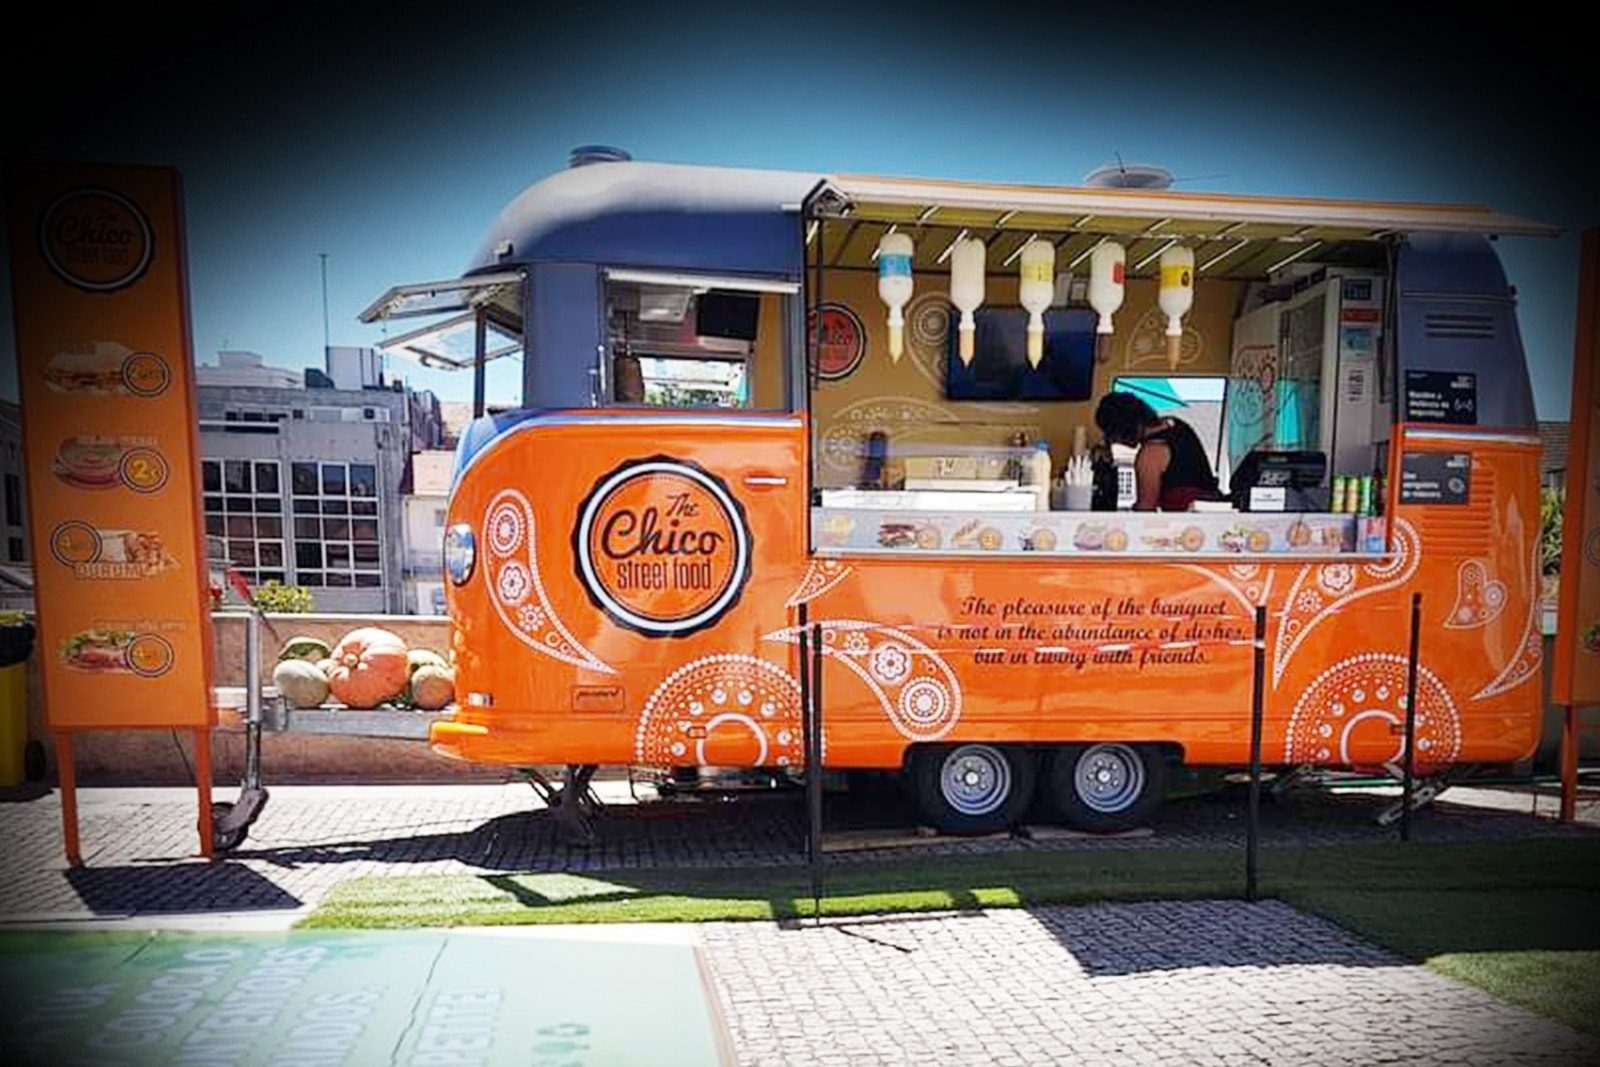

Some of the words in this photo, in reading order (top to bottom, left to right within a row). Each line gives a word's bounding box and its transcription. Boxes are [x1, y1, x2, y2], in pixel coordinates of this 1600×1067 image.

[55, 214, 136, 246] Chico
[666, 493, 699, 517] The
[601, 507, 724, 560] Chico
[617, 560, 667, 590] street
[673, 558, 711, 590] food
[961, 596, 997, 616] The
[1002, 598, 1085, 621] pleasure
[1091, 598, 1111, 621] of
[1117, 598, 1145, 616] the
[1151, 598, 1227, 621] banquet
[938, 625, 952, 640] is
[958, 625, 989, 640] not
[994, 626, 1012, 640] in
[1017, 623, 1046, 640] the
[1052, 623, 1151, 640] abundance
[1159, 622, 1181, 642] of
[974, 645, 1006, 664] but
[1010, 649, 1028, 664] in
[1093, 646, 1133, 664] with
